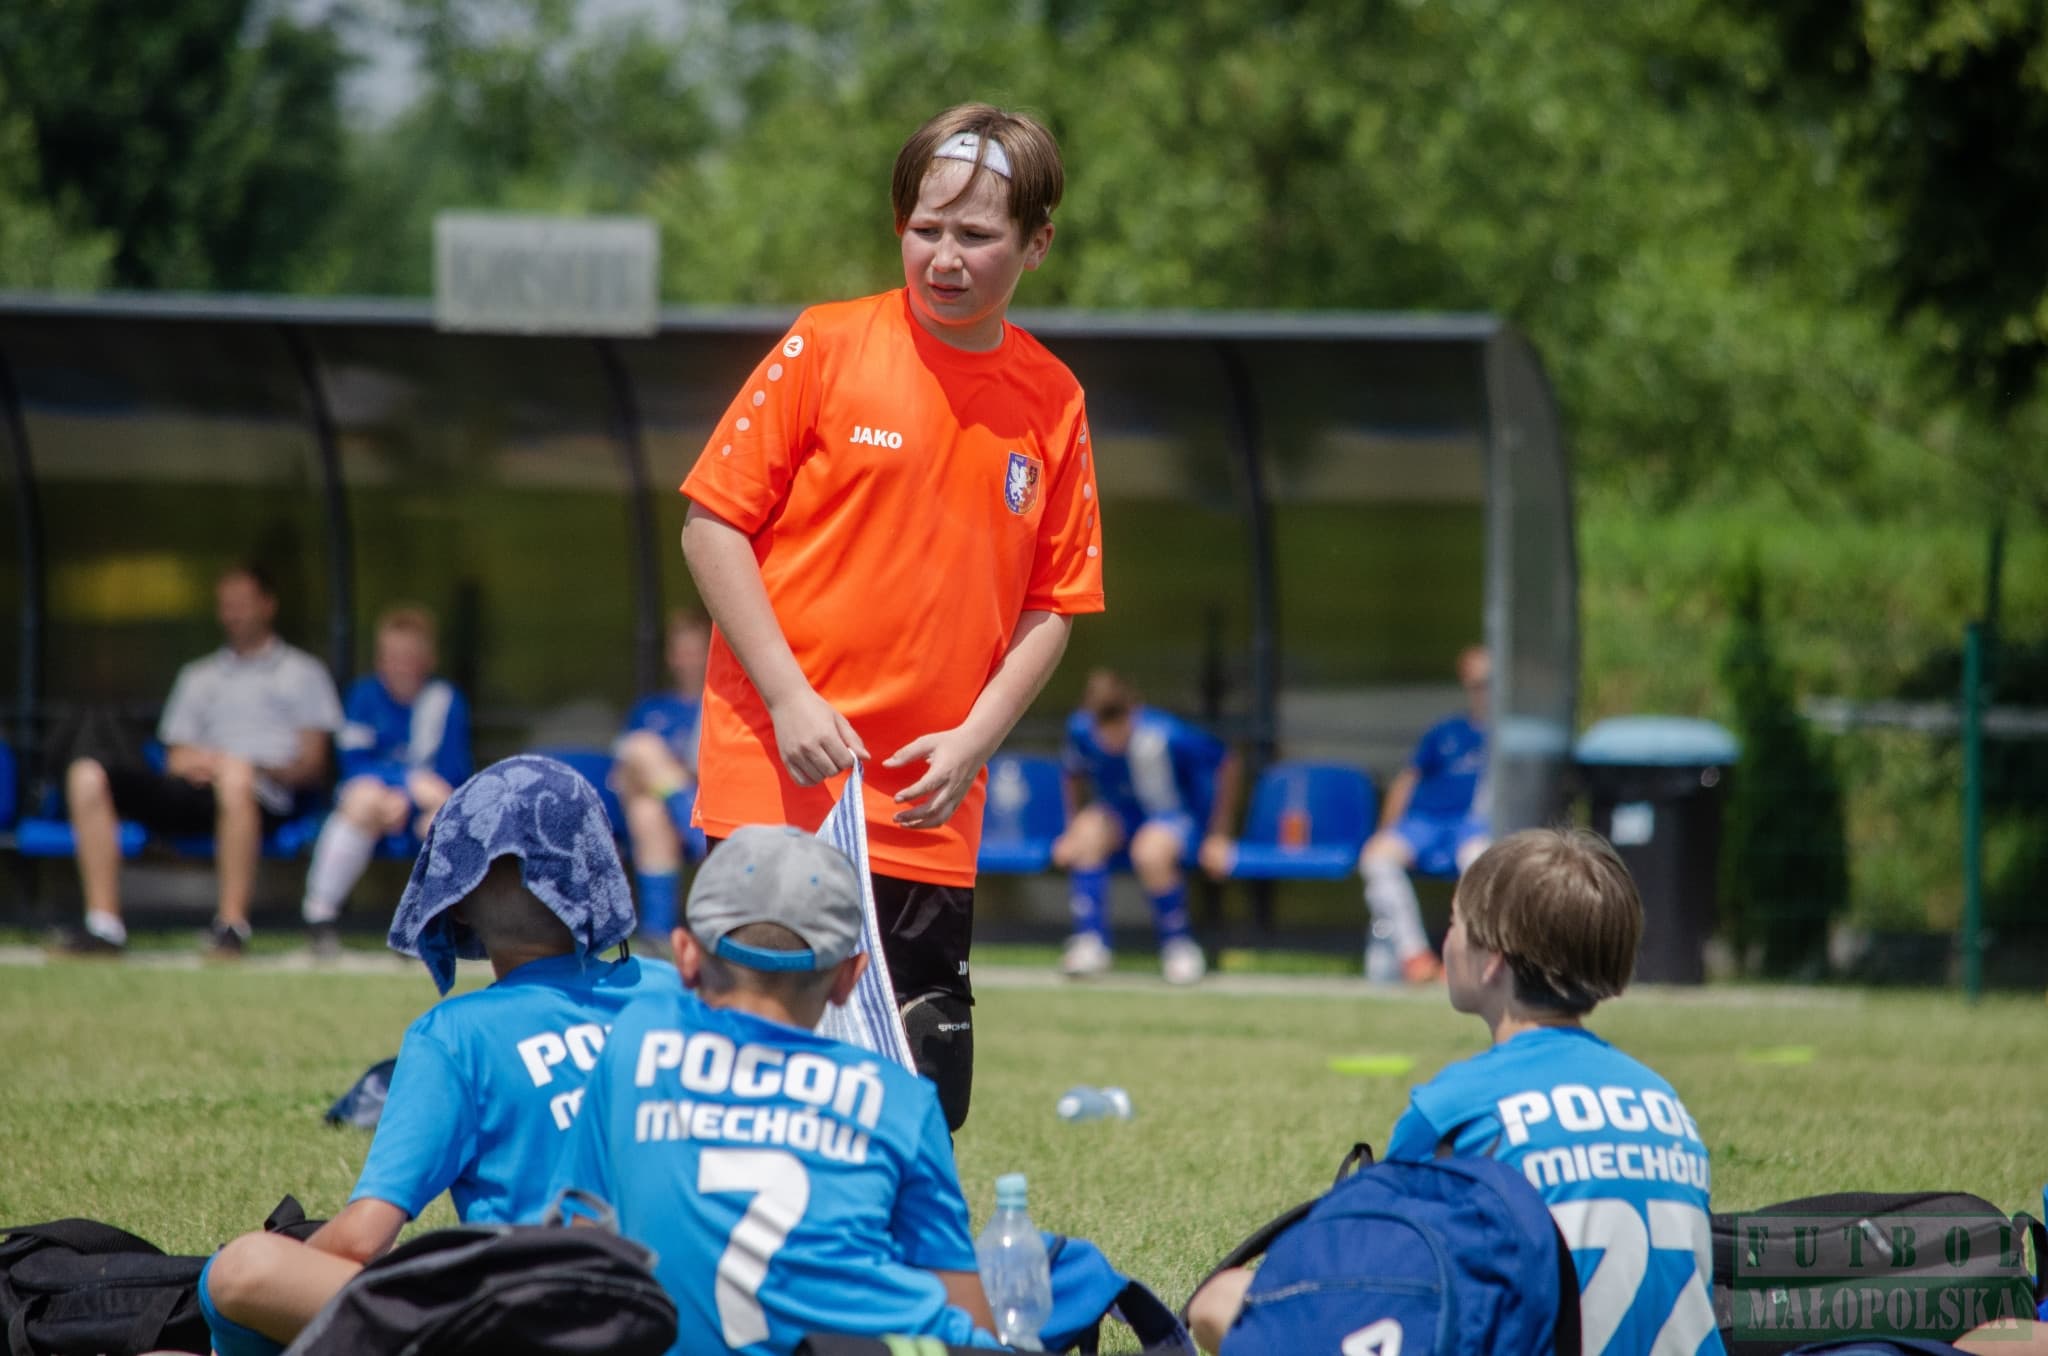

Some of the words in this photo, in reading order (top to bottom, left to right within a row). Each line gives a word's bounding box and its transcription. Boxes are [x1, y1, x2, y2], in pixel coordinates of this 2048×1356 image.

[849, 426, 902, 449] JAKO
[517, 1024, 612, 1089] PO
[634, 1030, 885, 1130] POGOŃ
[635, 1101, 870, 1164] MIECHÓW
[698, 1147, 809, 1349] 7
